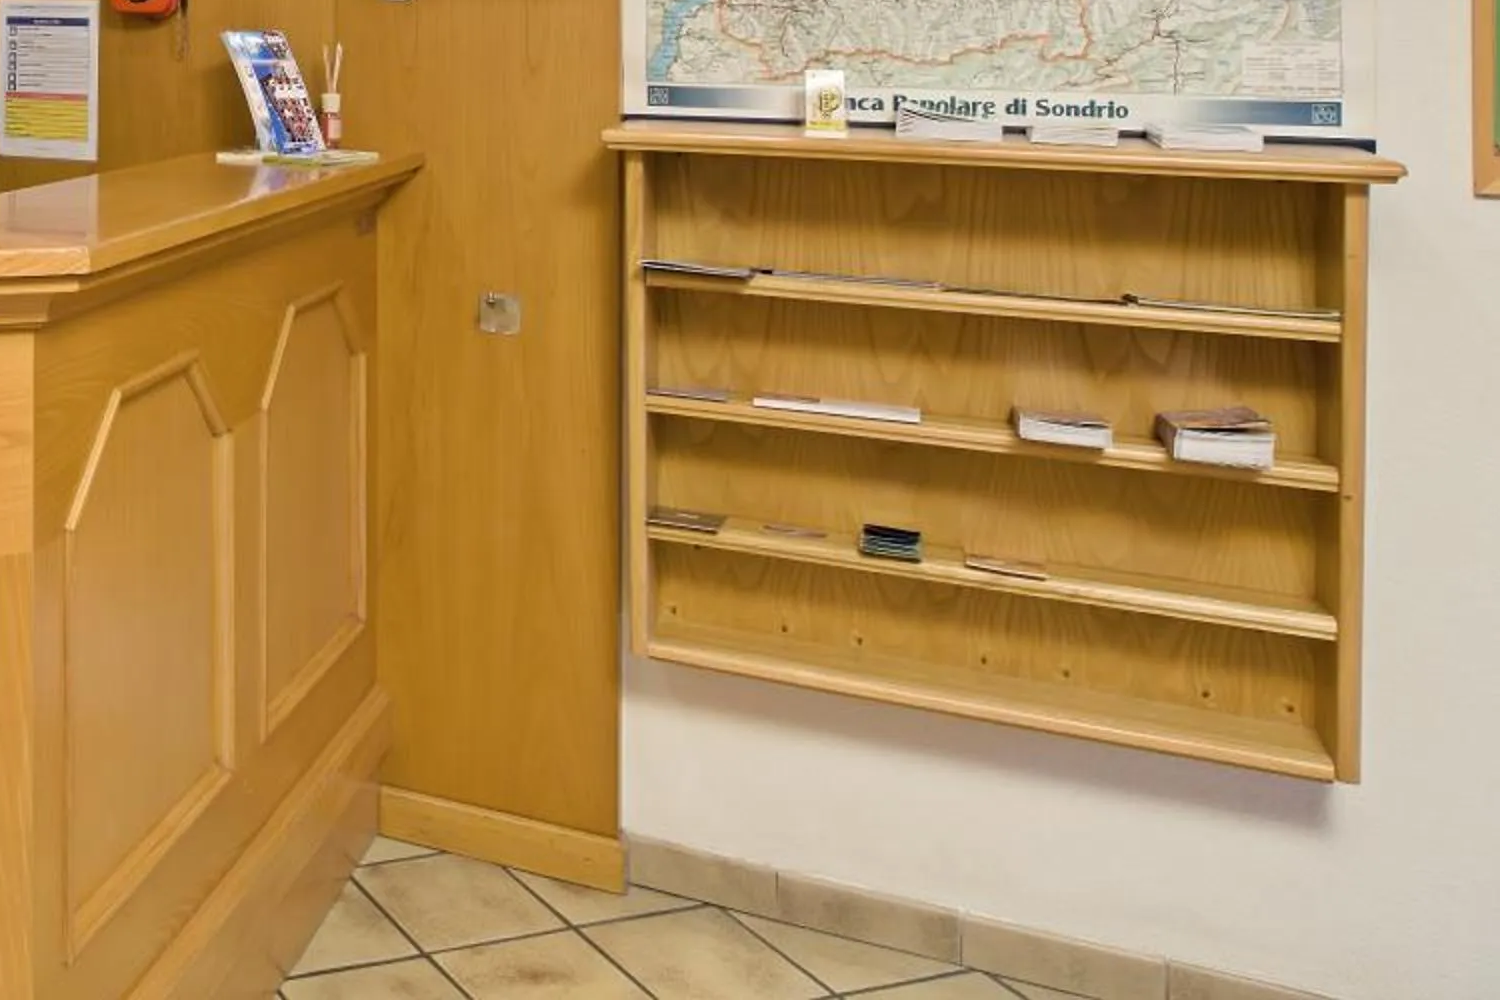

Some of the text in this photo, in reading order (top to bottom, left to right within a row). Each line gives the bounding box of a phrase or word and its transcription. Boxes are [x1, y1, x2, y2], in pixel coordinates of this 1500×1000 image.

[844, 96, 885, 111] nca
[893, 94, 996, 119] Ppolare
[1005, 98, 1027, 116] di
[1036, 99, 1129, 119] Sondrio
